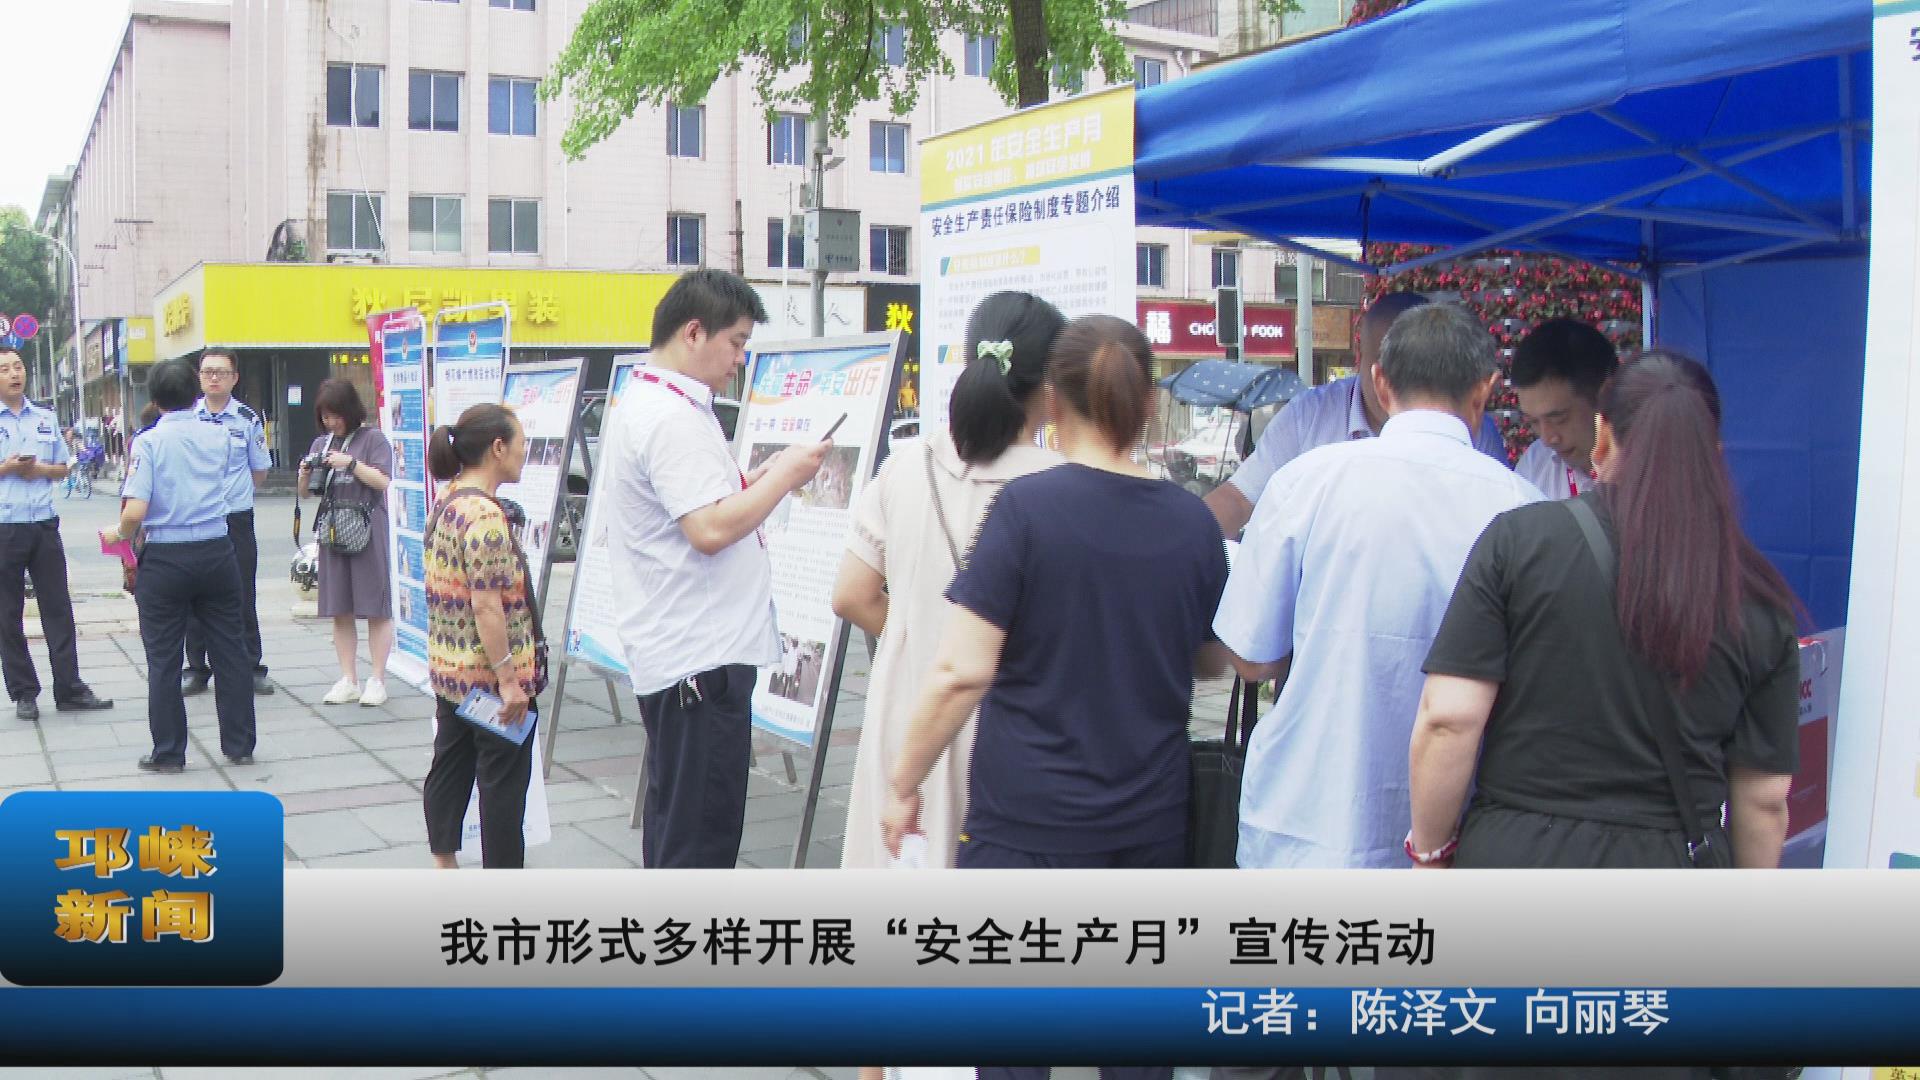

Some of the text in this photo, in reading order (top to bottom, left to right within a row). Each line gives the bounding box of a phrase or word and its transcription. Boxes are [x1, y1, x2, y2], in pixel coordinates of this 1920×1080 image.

[946, 143, 985, 172] 2021
[931, 184, 1120, 238] 安全生产责任保险制度专题介绍
[1146, 310, 1172, 344] 福
[1189, 322, 1217, 337] CHO
[1251, 324, 1284, 338] FOOK
